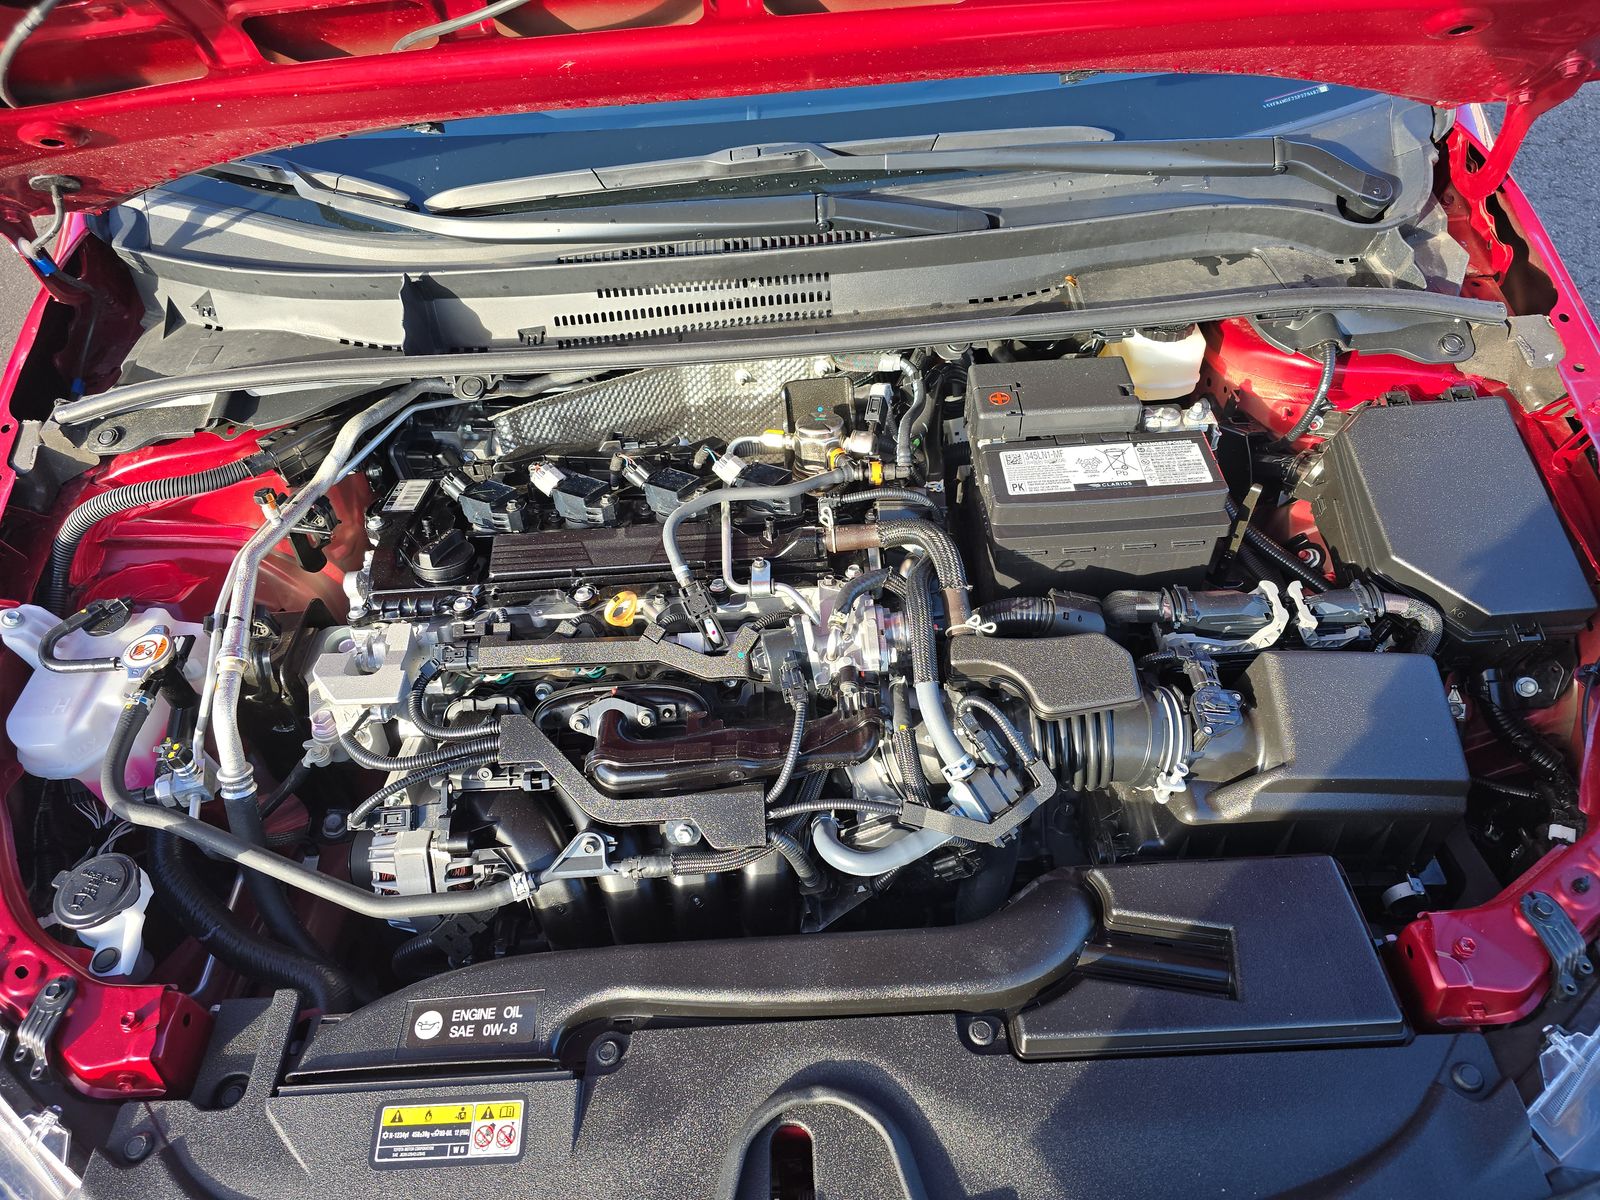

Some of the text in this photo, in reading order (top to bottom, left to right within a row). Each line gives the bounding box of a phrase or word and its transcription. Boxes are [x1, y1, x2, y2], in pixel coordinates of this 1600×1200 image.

[1024, 449, 1063, 461] 345LN1-MF
[1011, 482, 1026, 492] PK
[451, 1005, 523, 1021] ENGINE OIL
[449, 1022, 518, 1038] SAE 0W-8
